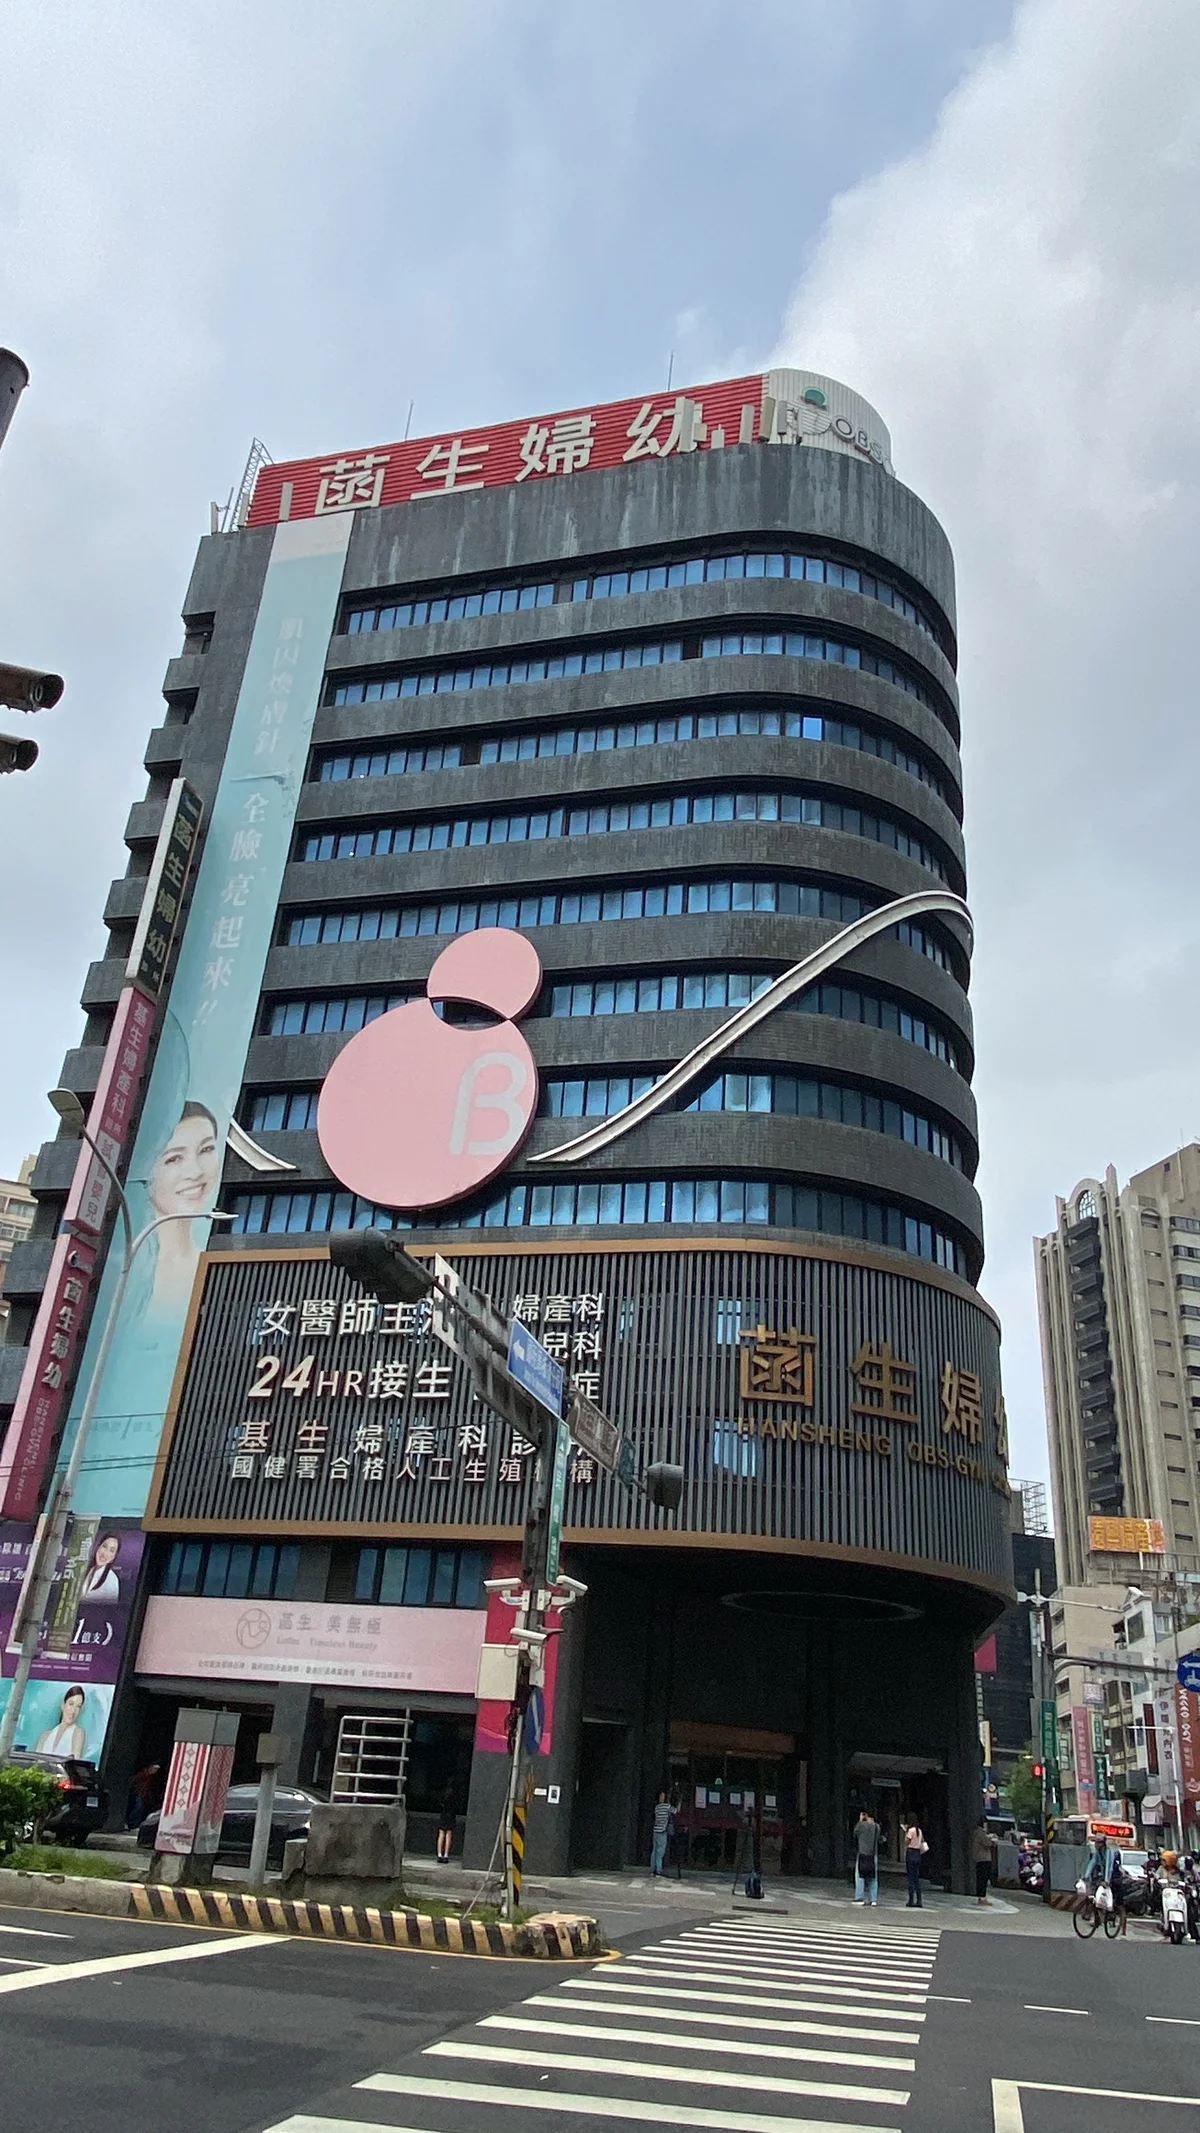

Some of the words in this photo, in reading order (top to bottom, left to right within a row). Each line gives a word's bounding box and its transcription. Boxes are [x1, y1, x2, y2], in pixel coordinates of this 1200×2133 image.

[511, 1292, 606, 1324] 婦產科
[236, 1419, 592, 1458] 基生婦產科診
[738, 1415, 893, 1457] HANSHENG
